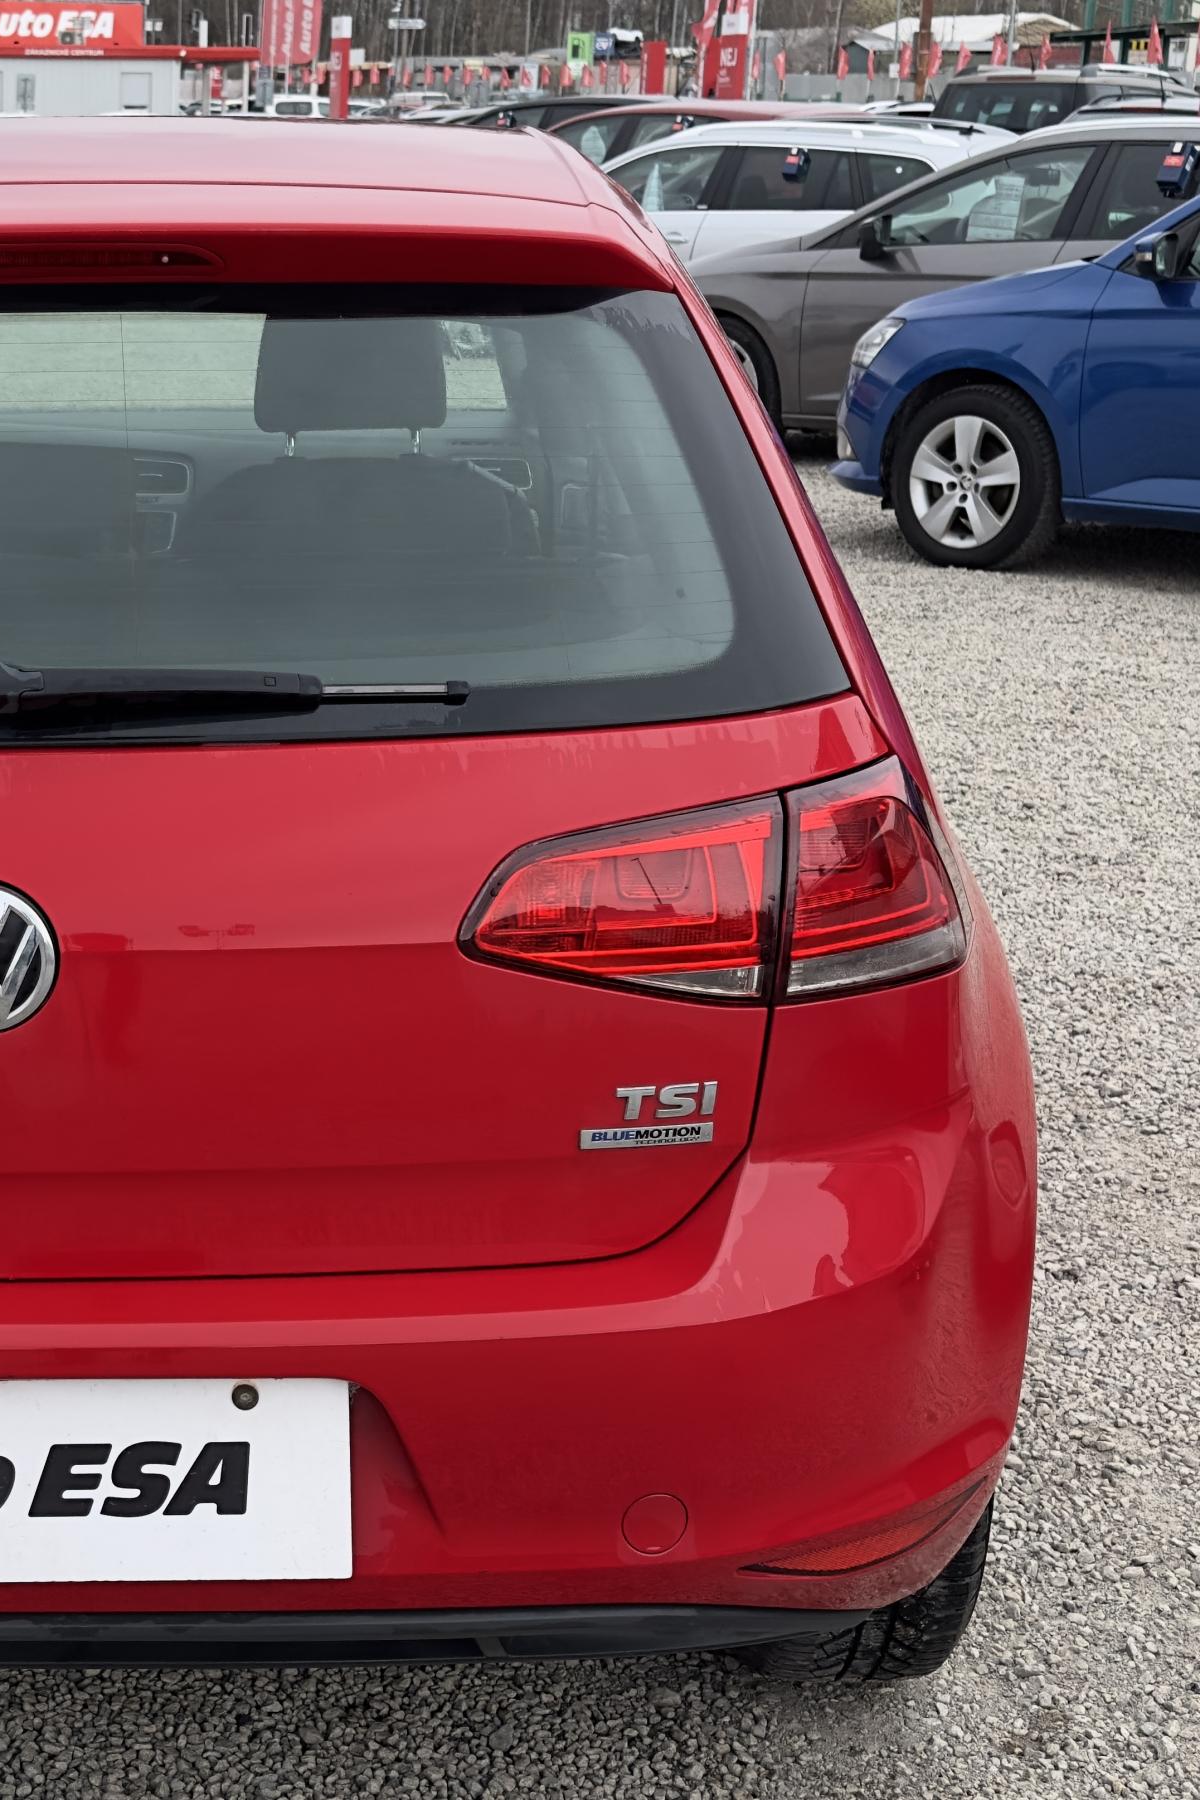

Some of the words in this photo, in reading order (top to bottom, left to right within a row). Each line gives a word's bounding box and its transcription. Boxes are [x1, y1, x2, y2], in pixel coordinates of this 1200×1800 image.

[300, 9, 313, 55] Auto
[719, 47, 738, 67] NEJ
[616, 1080, 718, 1120] TSI
[591, 1126, 702, 1142] BLUEMOTION
[634, 1136, 701, 1145] TECHNOLOGY
[28, 1441, 250, 1518] ESA
